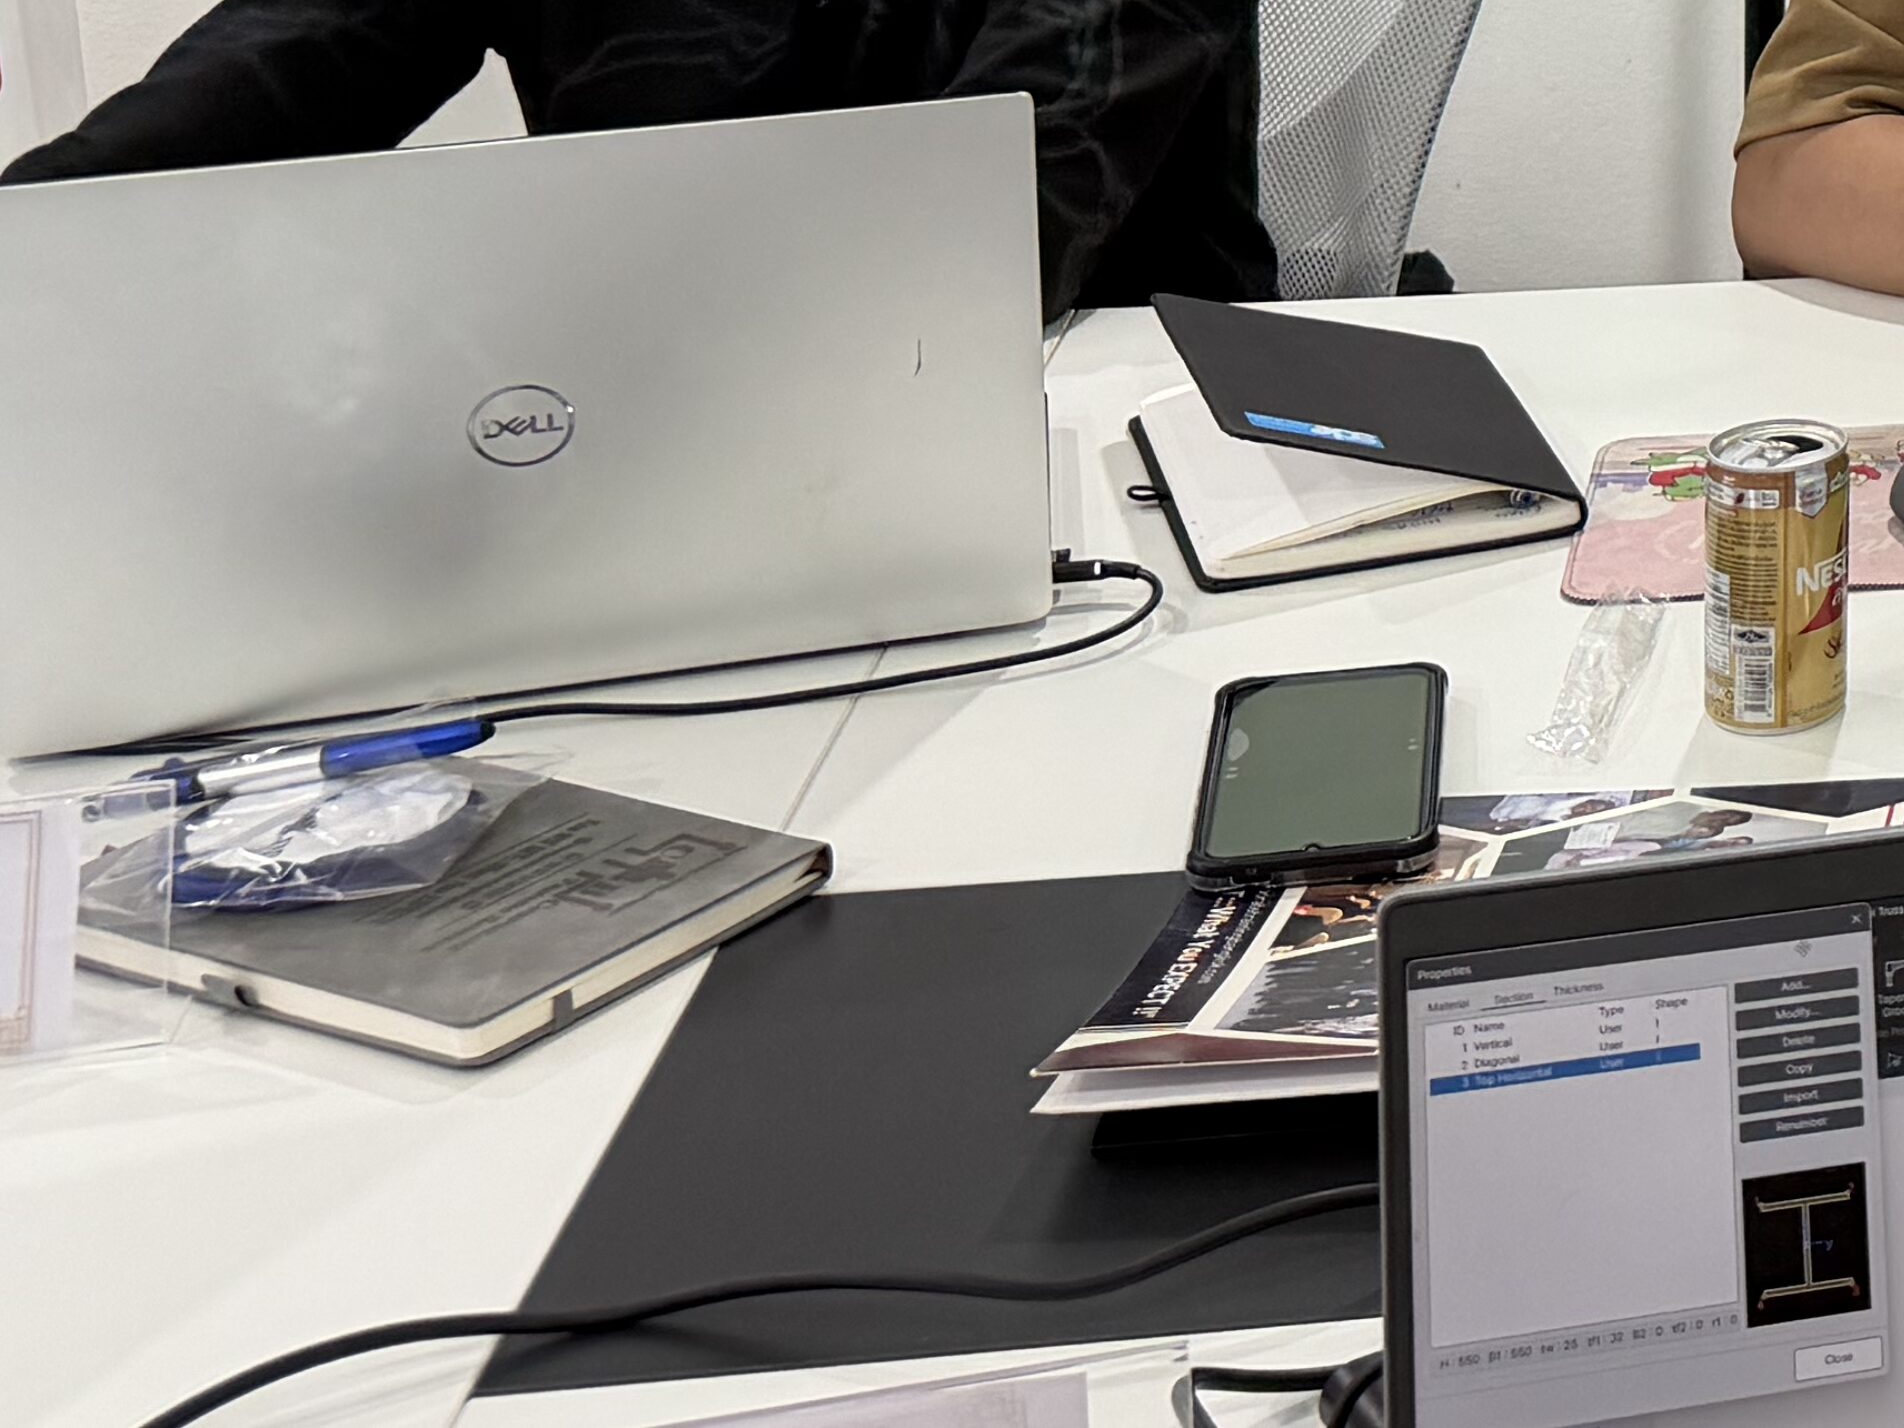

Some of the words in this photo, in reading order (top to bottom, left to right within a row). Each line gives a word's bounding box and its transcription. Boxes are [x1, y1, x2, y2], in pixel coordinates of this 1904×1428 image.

[482, 412, 565, 438] DELL
[1416, 964, 1473, 981] Properties
[1552, 981, 1605, 997] Thickness
[1473, 1020, 1506, 1033] Name
[1598, 1004, 1625, 1018] Type
[1654, 996, 1689, 1011] Shape
[1823, 1350, 1854, 1366] Close
